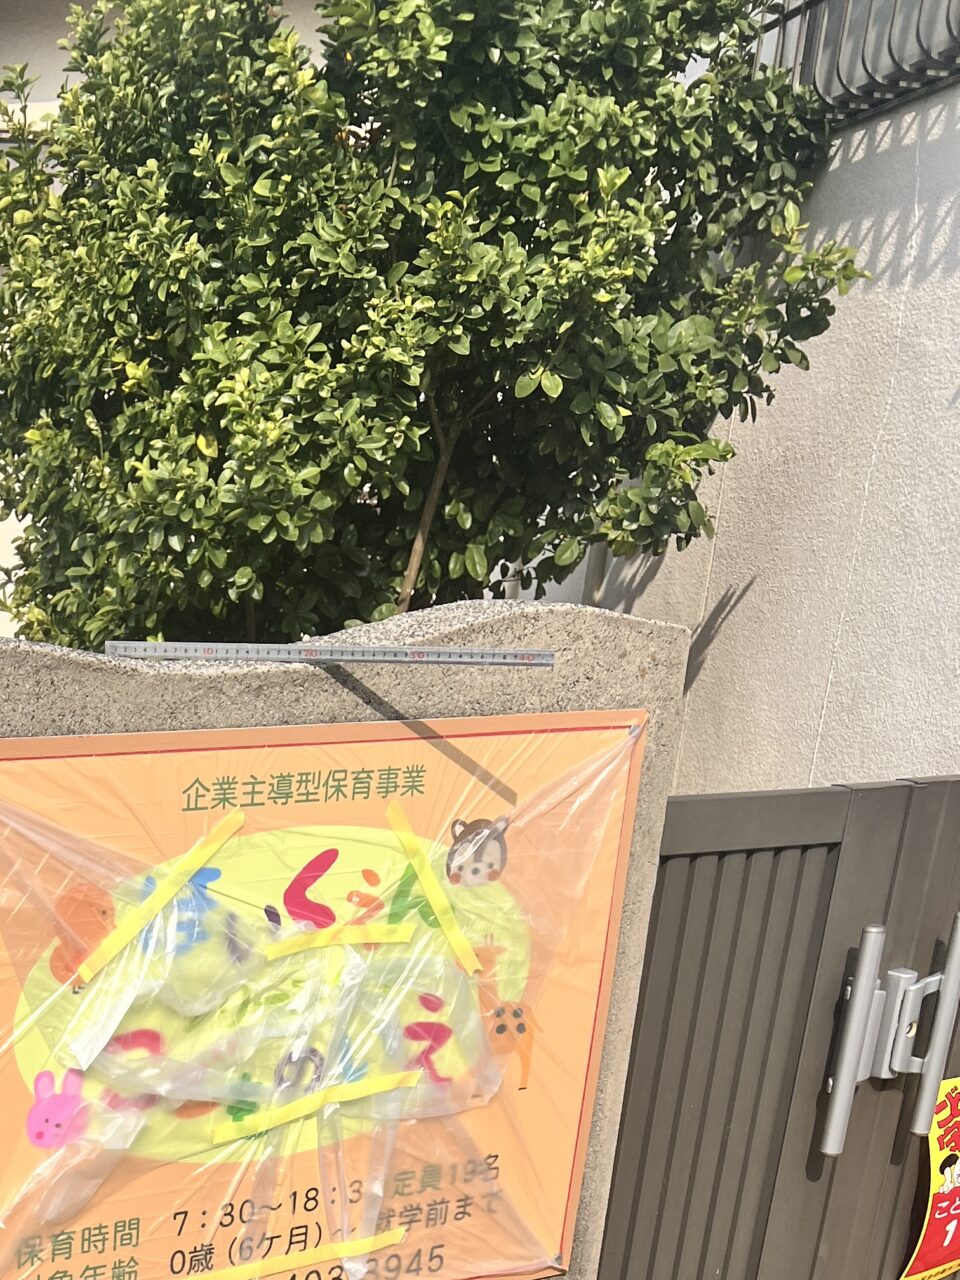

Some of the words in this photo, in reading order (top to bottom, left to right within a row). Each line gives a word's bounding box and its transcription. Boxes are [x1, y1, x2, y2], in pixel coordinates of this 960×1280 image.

[181, 764, 427, 812] 企業主導型保育事業
[16, 1217, 140, 1269] 保育時間
